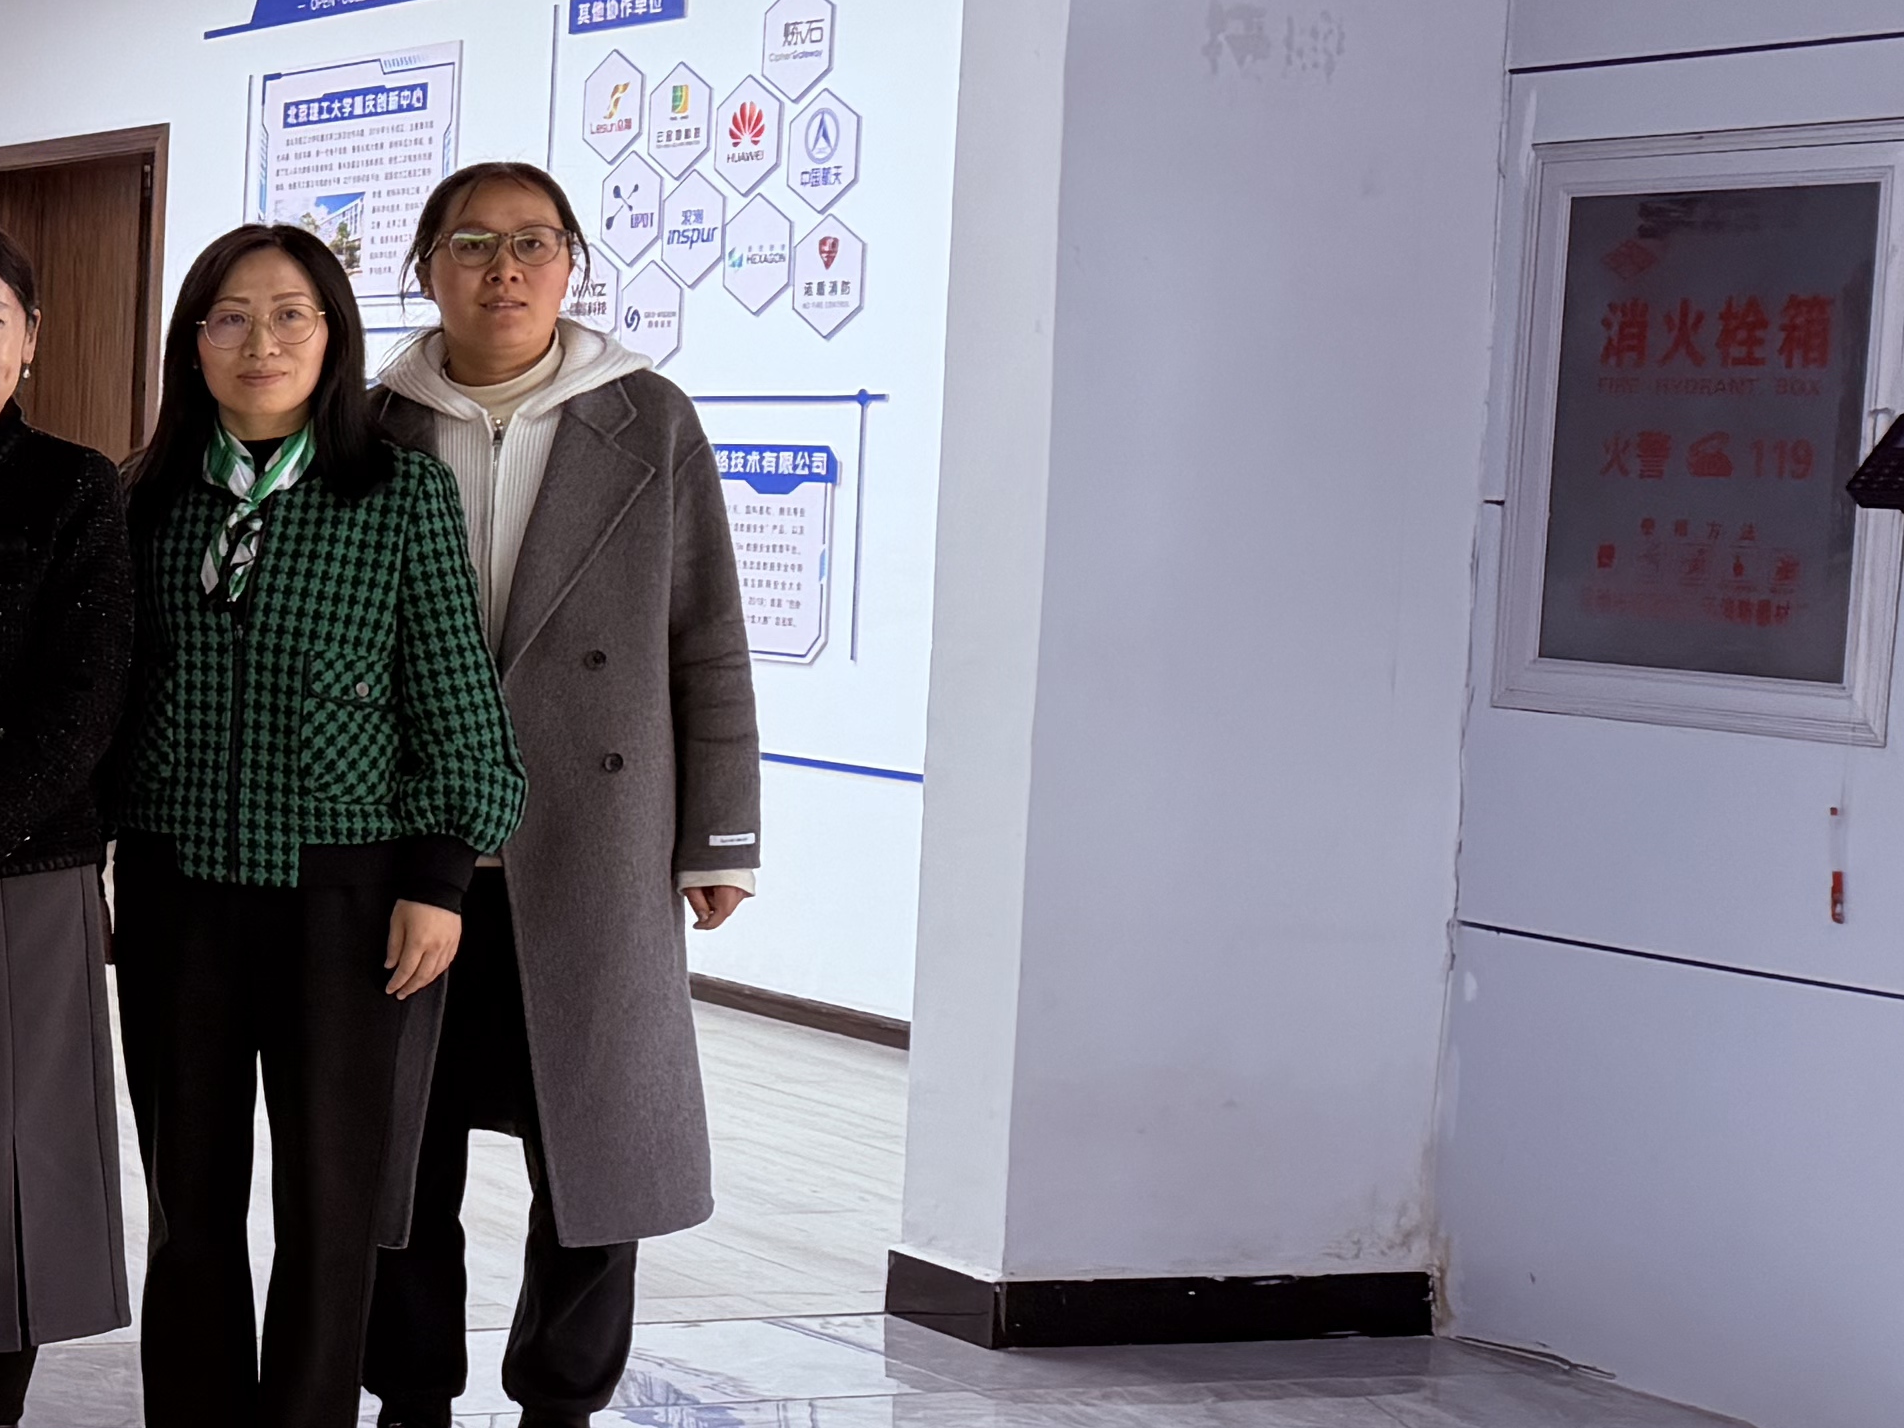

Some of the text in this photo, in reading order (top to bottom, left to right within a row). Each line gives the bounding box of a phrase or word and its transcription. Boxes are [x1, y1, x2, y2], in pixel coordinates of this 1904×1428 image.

[286, 86, 425, 124] 北京理工大学重庆创新中心
[726, 149, 765, 164] HUAWEI
[666, 226, 719, 250] inspur
[1600, 293, 1836, 369] 消火栓箱
[1598, 377, 1640, 395] FIRE
[1775, 377, 1821, 395] BOX
[1600, 430, 1816, 481] 火警 119
